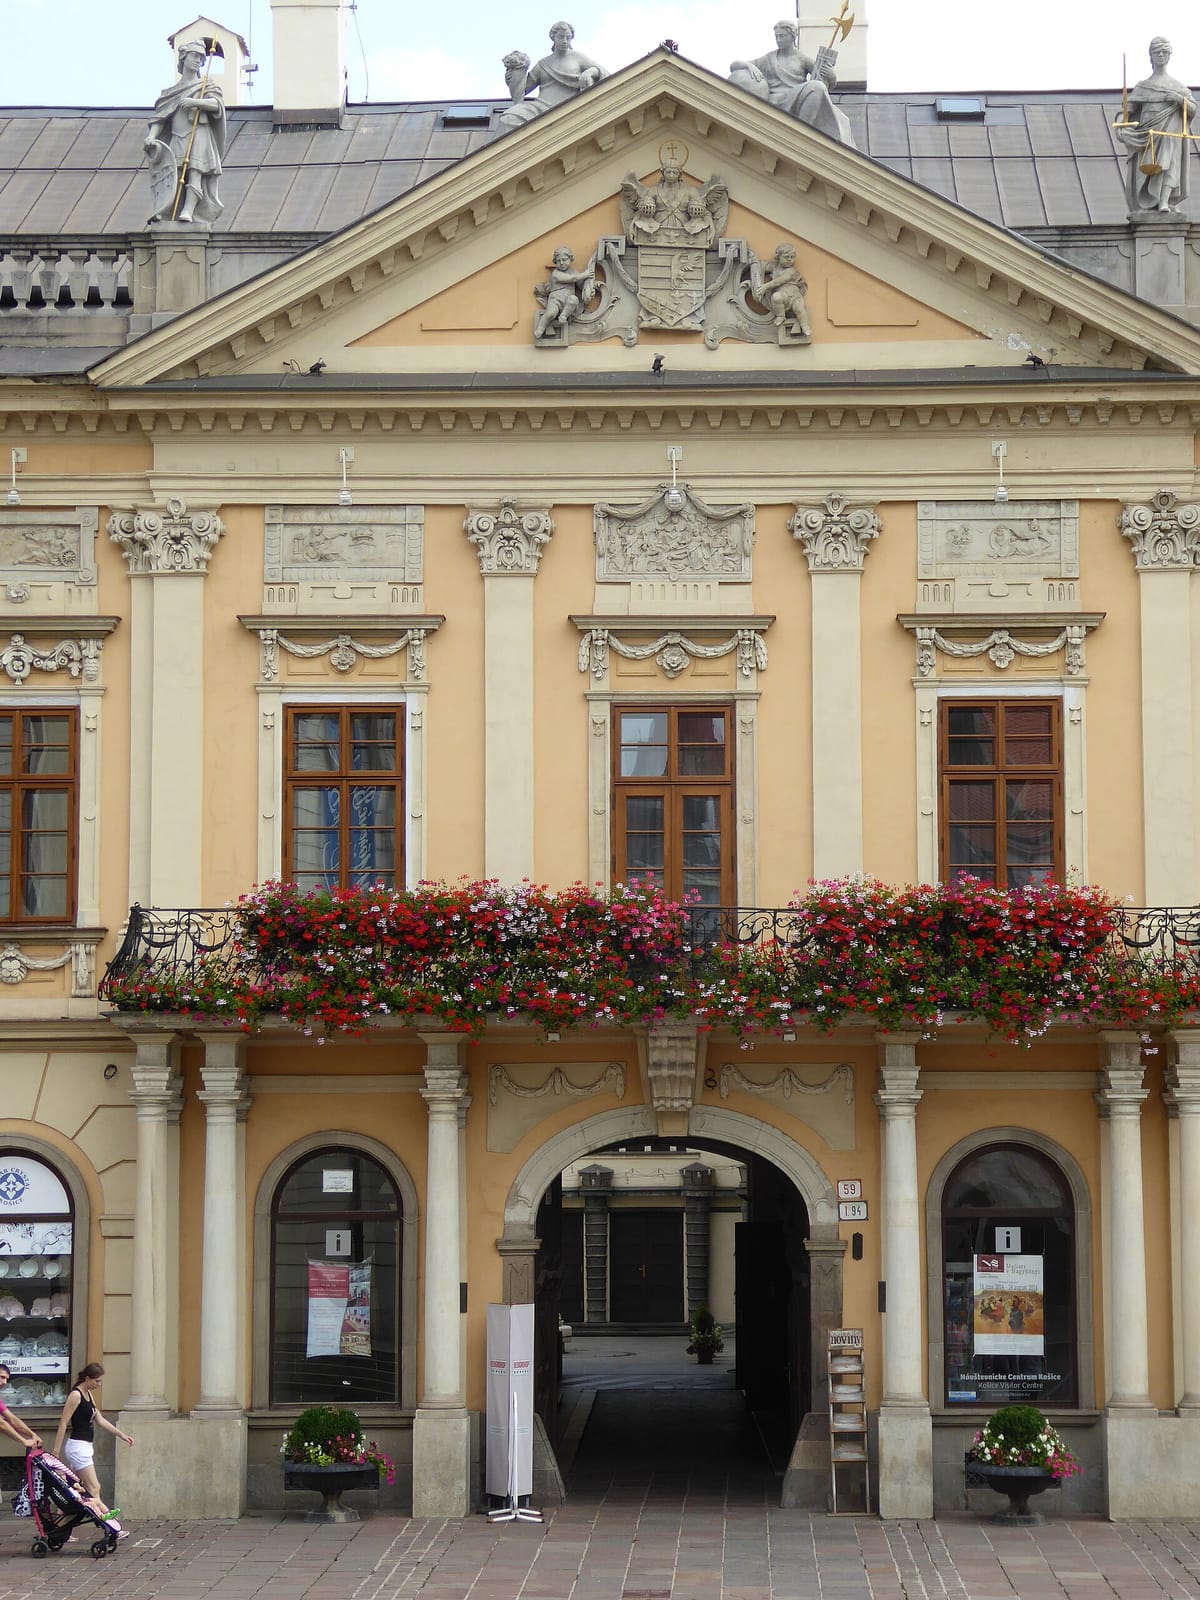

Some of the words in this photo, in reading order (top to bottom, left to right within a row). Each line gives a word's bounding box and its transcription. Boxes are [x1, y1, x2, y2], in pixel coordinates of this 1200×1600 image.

[10, 1167, 30, 1189] CRYSTAL
[843, 1183, 856, 1195] 59
[831, 1335, 861, 1346] noviny
[1038, 1372, 1062, 1380] Košice
[978, 1381, 999, 1389] Košice
